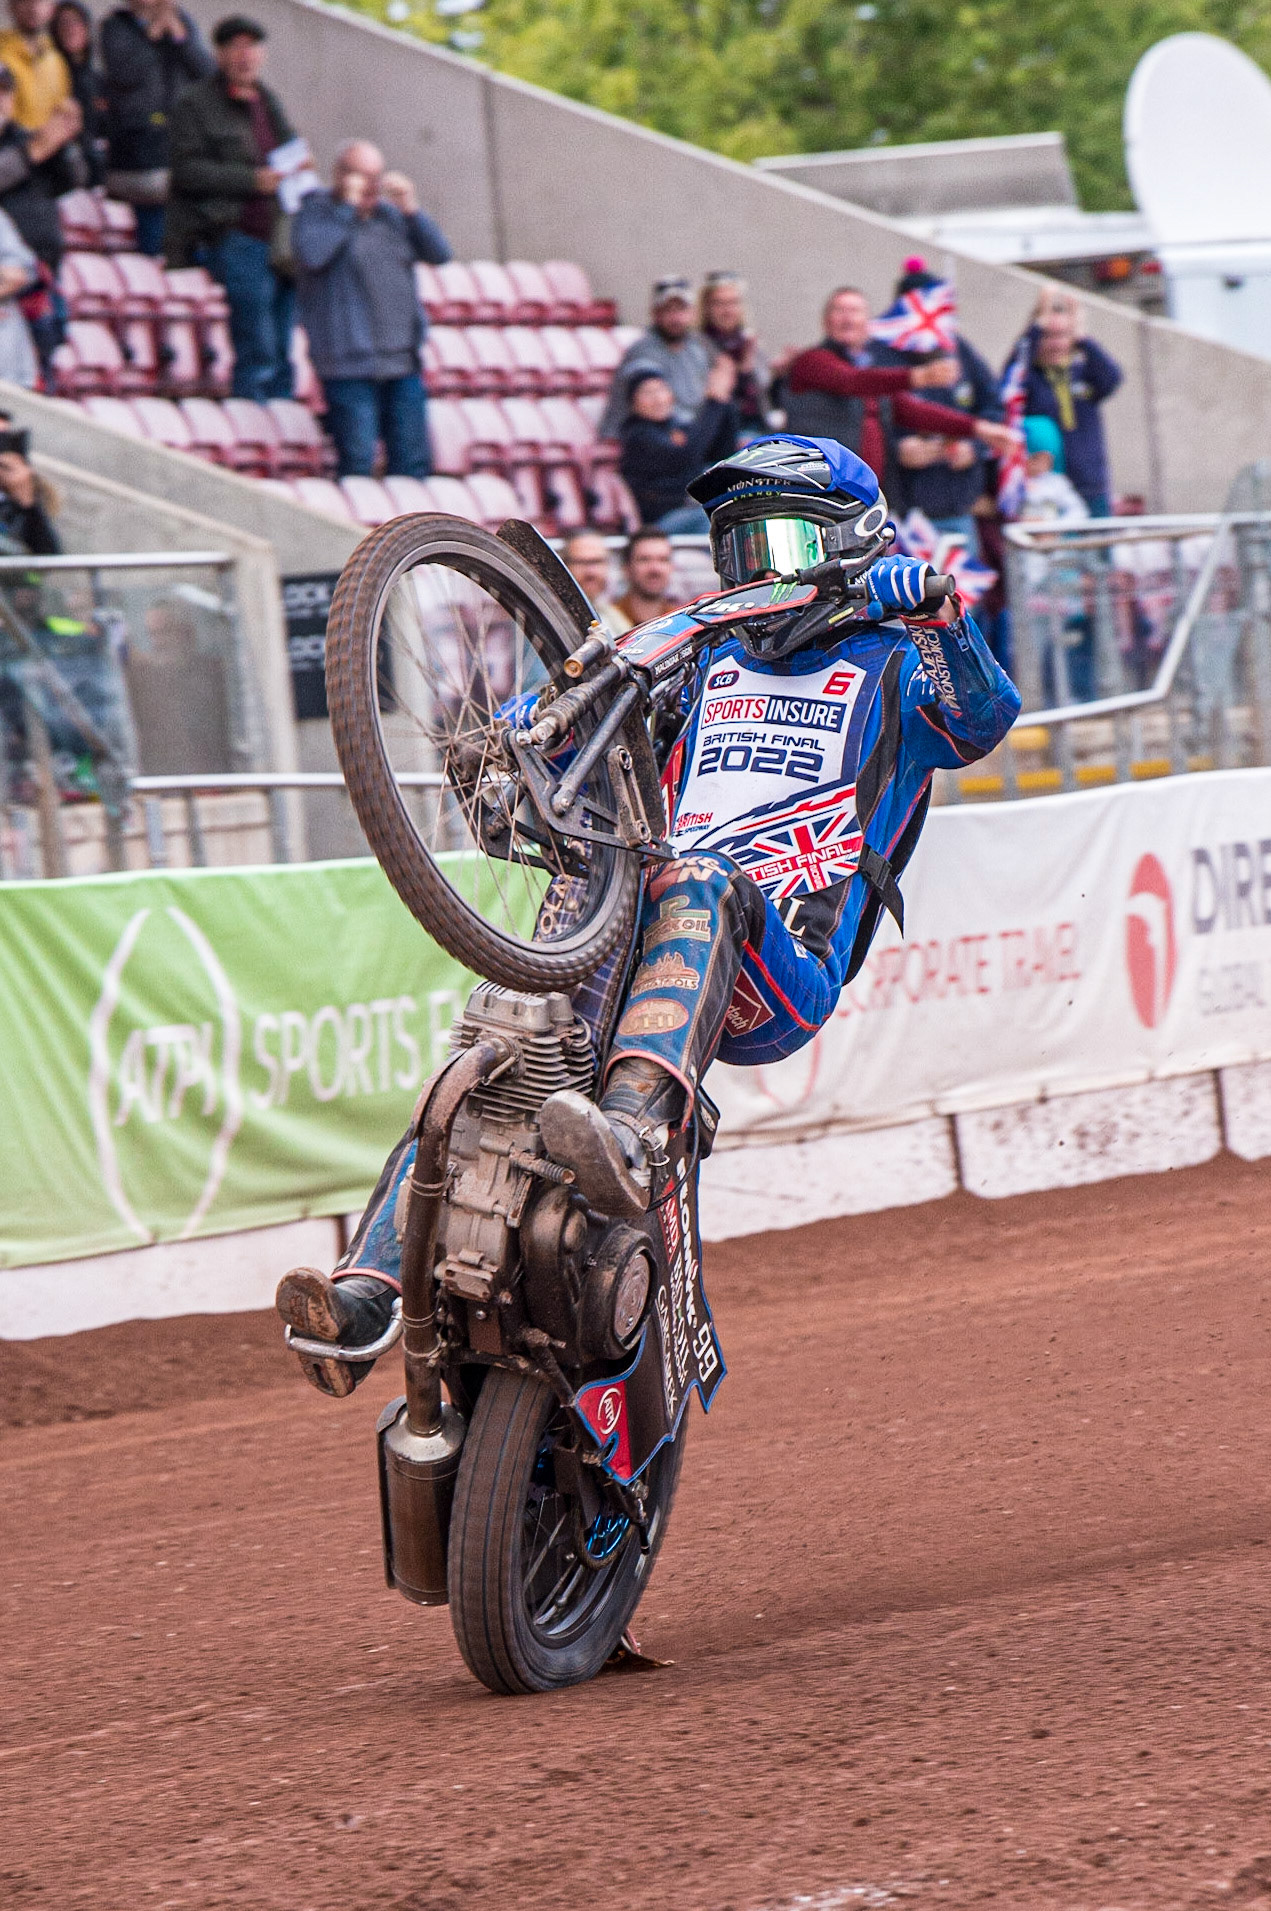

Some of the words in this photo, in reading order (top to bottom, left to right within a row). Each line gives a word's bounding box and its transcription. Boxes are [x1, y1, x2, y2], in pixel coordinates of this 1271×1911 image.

[727, 478, 791, 493] MONSTER
[713, 673, 734, 686] SCB
[822, 671, 857, 696] 6
[703, 732, 767, 747] BRITISH
[770, 734, 826, 752] FINAL
[697, 745, 824, 784] 2022
[745, 858, 793, 881] TISH
[795, 842, 853, 868] FINAL
[250, 995, 422, 1110] SPORTS
[692, 1321, 719, 1383] 99
